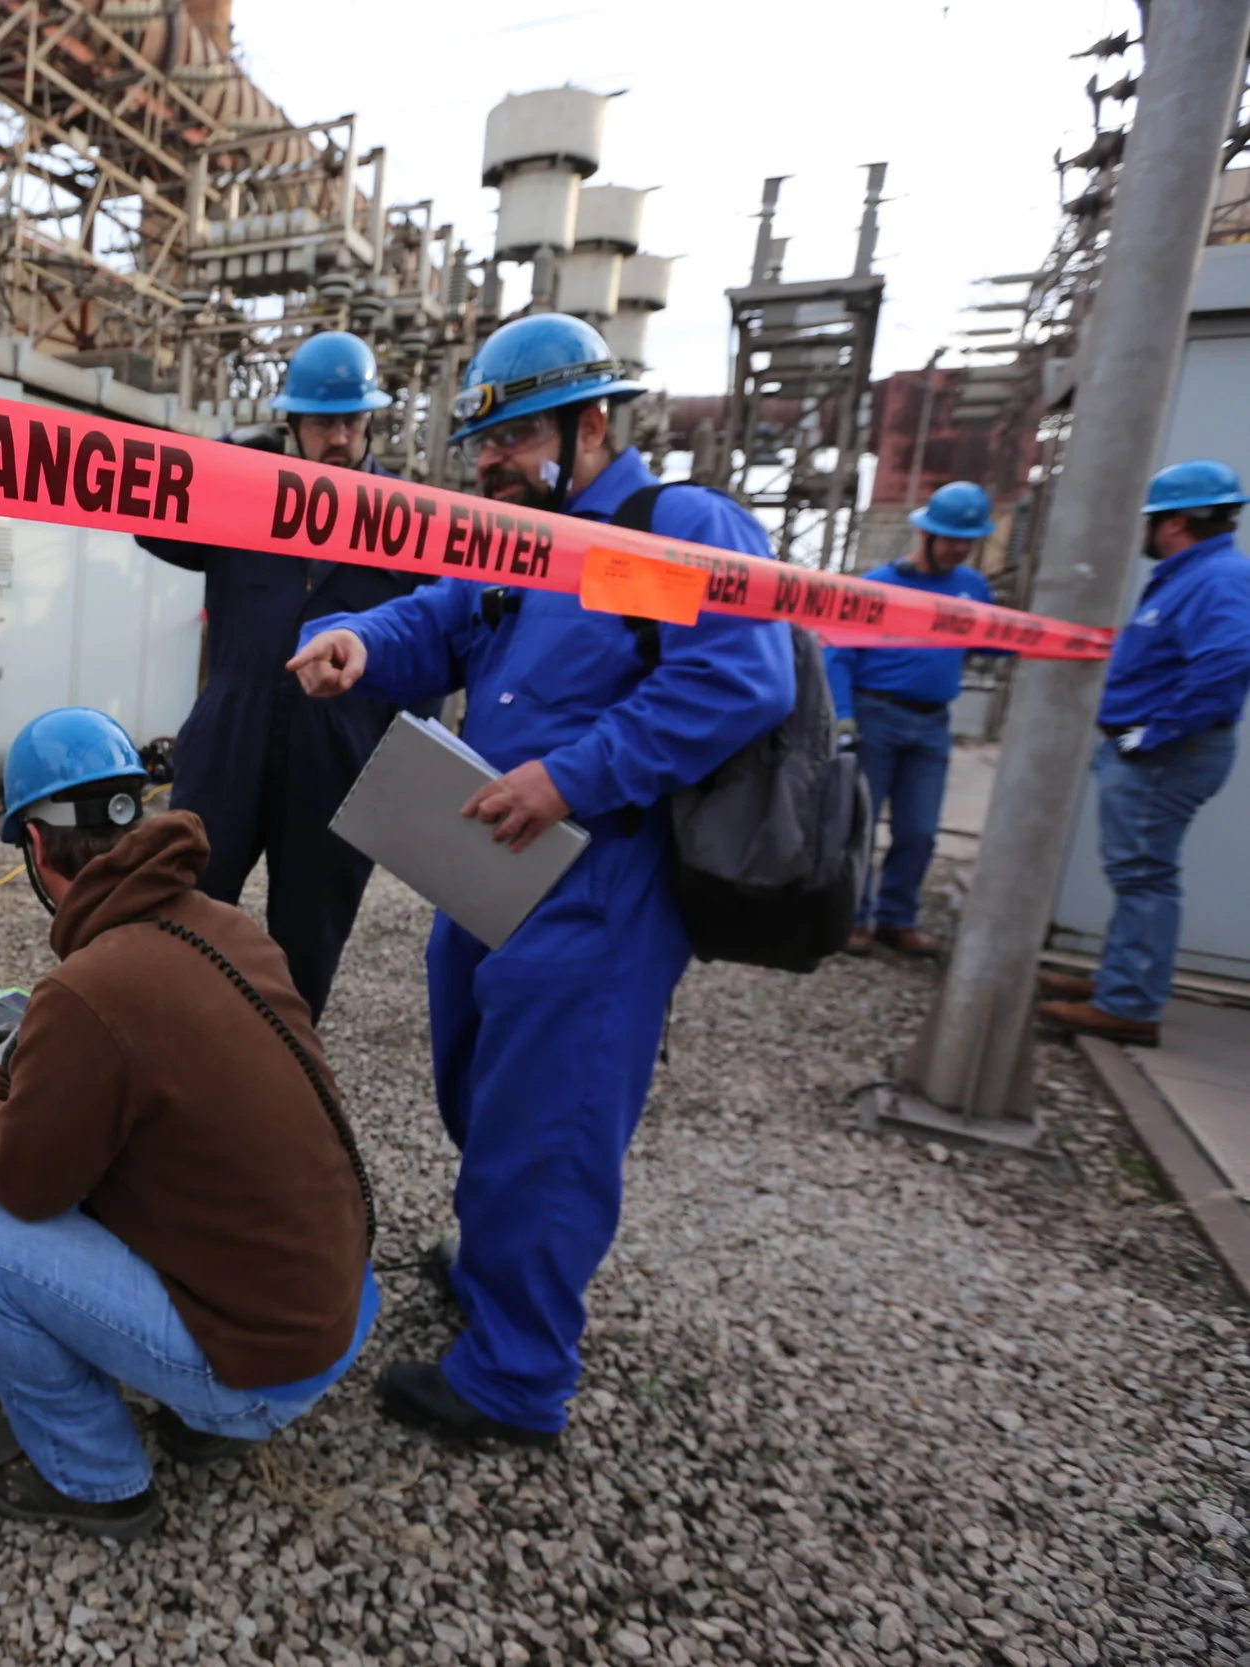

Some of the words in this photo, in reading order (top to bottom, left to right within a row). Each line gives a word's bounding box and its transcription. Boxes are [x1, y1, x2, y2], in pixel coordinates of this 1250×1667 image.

[271, 470, 339, 547] DO
[349, 485, 438, 559] NOT
[443, 504, 554, 579] ENTER
[773, 572, 802, 613] DO
[802, 578, 838, 618] NOT
[838, 584, 887, 626] ENTER
